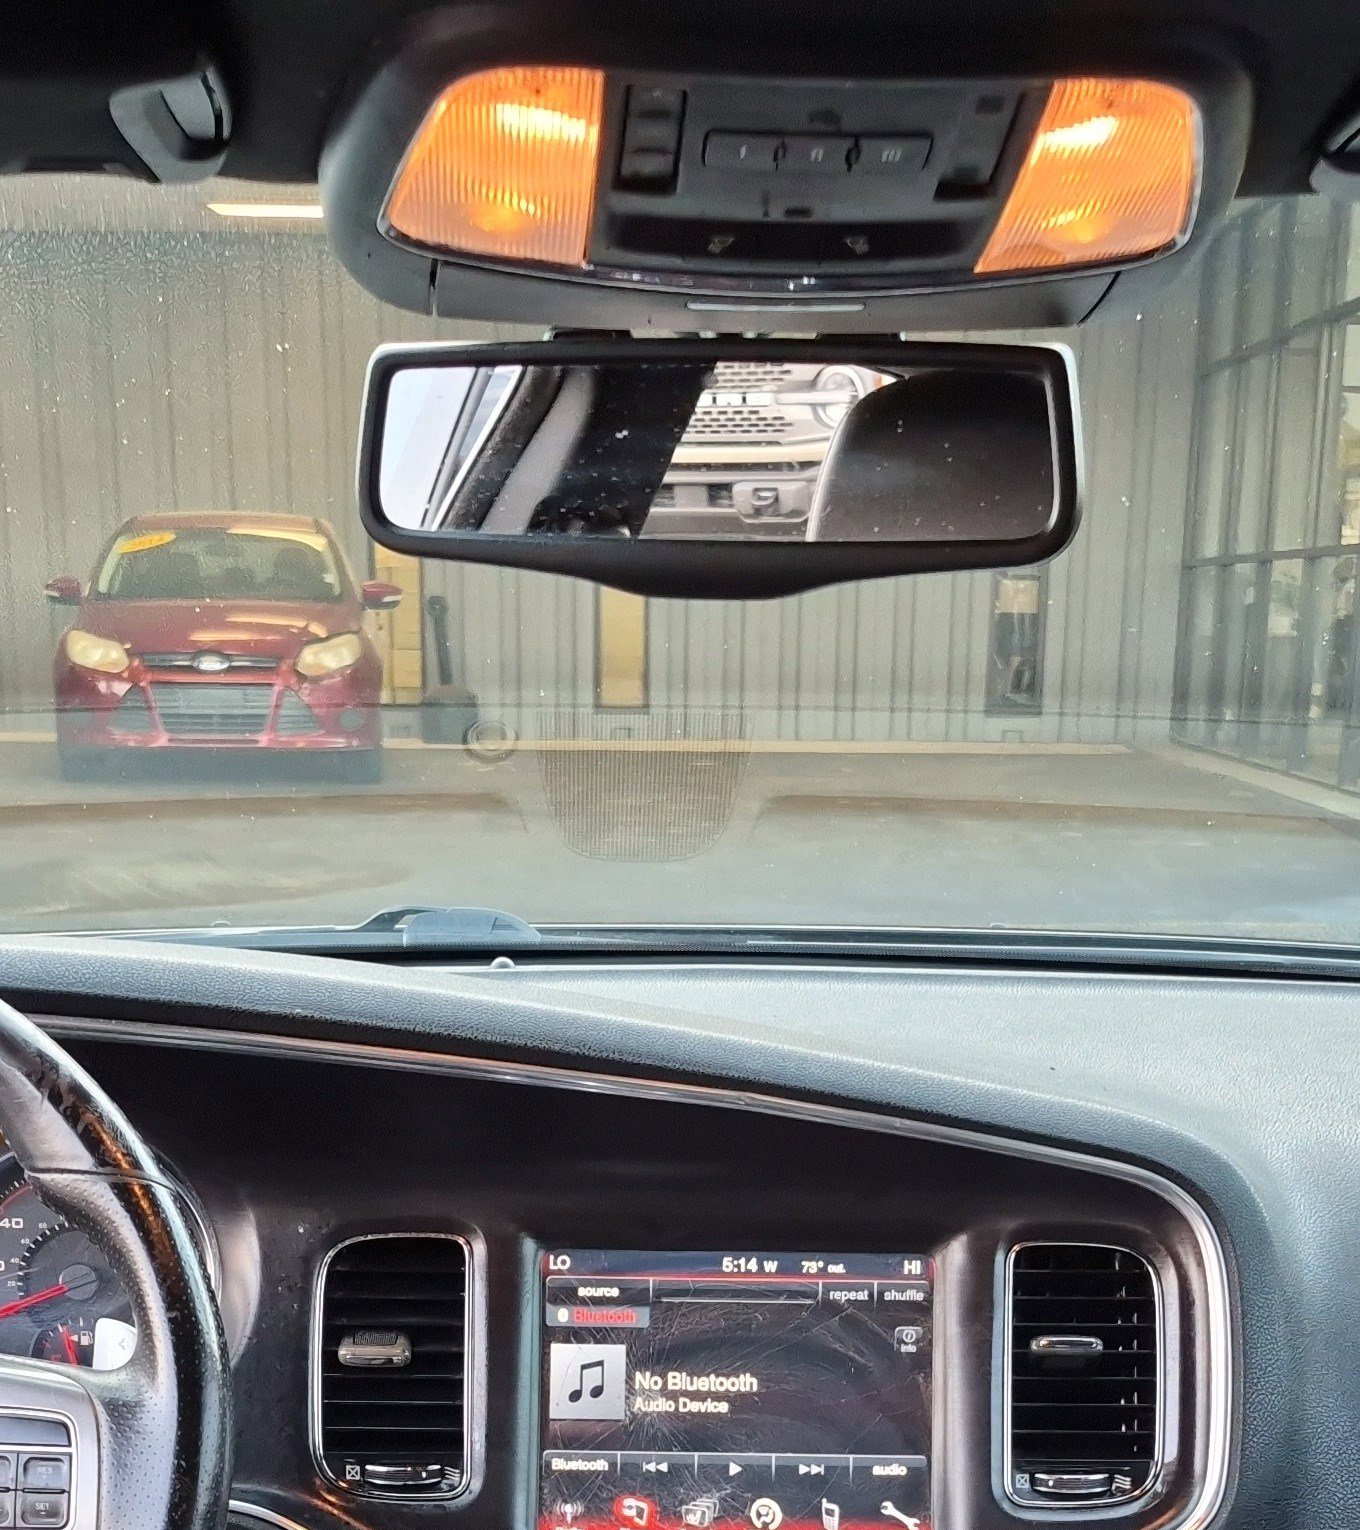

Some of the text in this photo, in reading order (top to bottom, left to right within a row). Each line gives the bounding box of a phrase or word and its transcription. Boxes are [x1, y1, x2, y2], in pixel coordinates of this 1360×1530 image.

[549, 1256, 571, 1269] LO
[722, 1258, 758, 1273] 5:14
[764, 1260, 778, 1273] W
[904, 1261, 921, 1275] HI
[577, 1286, 619, 1297] source
[830, 1289, 869, 1302] repeat
[884, 1289, 924, 1302] shuffle
[573, 1309, 636, 1324] Bluetooth
[634, 1372, 758, 1392] No Bluetooth
[634, 1397, 729, 1413] Audio Device
[551, 1458, 609, 1471] Bluetooth
[872, 1464, 907, 1475] audio
